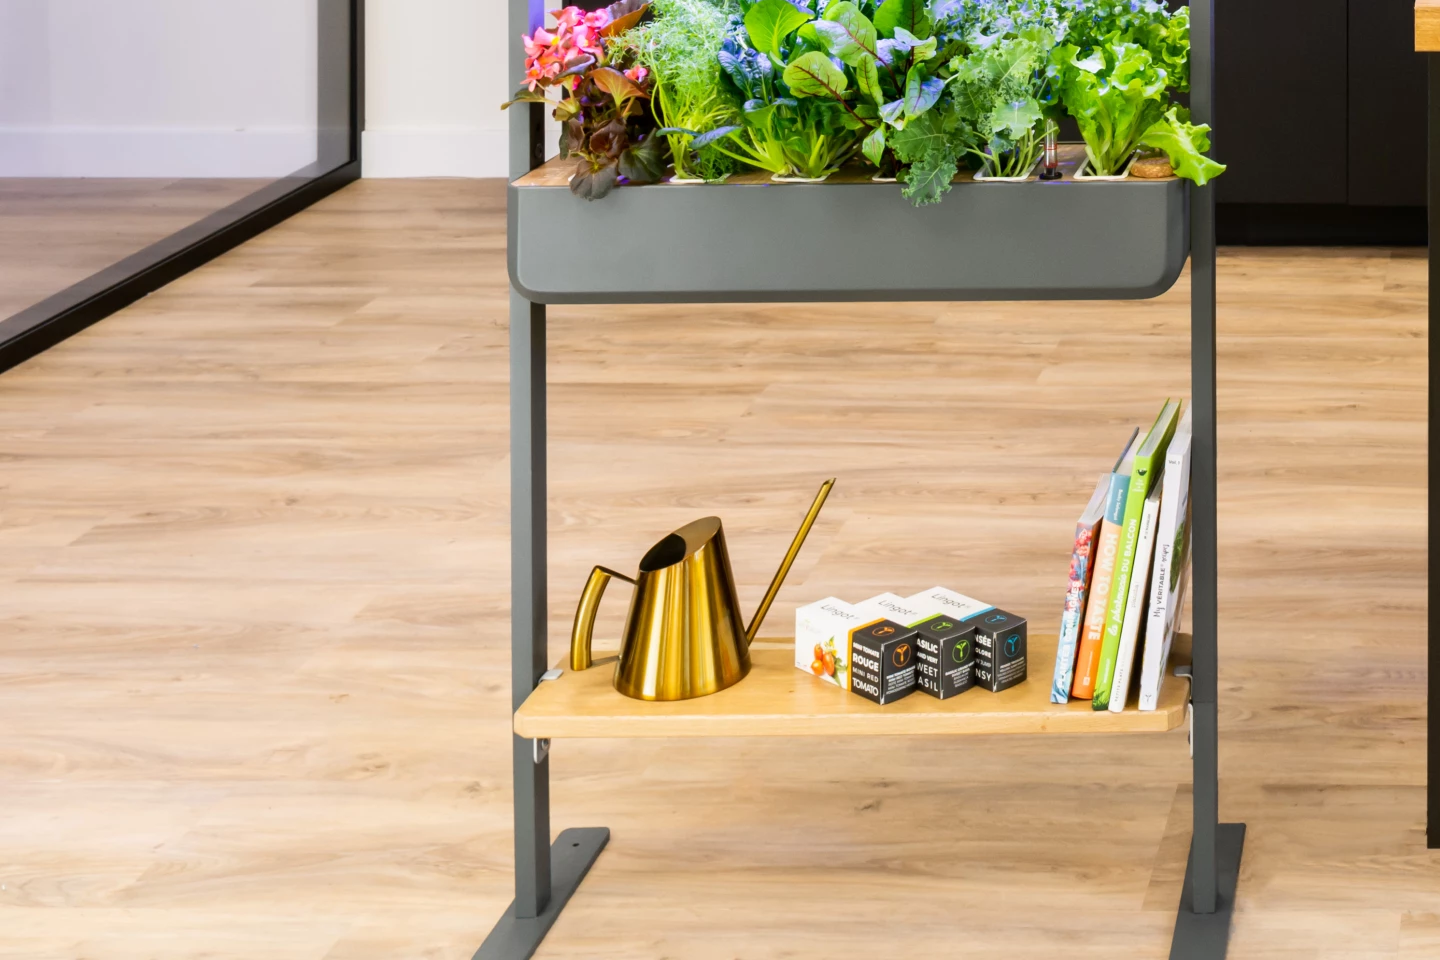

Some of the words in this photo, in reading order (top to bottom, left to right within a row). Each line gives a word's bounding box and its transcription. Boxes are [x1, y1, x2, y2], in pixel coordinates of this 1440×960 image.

[1124, 519, 1137, 557] BALCON
[1101, 533, 1119, 572] HOW
[1121, 560, 1130, 572] DU
[1096, 576, 1111, 595] TO
[1088, 599, 1107, 640] TASTE
[917, 638, 938, 653] ASILIC
[853, 652, 879, 672] ROUGE
[917, 651, 926, 660] AND
[927, 655, 938, 664] VERT
[916, 662, 938, 677] WEET
[975, 668, 991, 681] NSY
[866, 672, 878, 683] RED
[918, 676, 938, 691] ASIL
[852, 677, 879, 696] TOMATO
